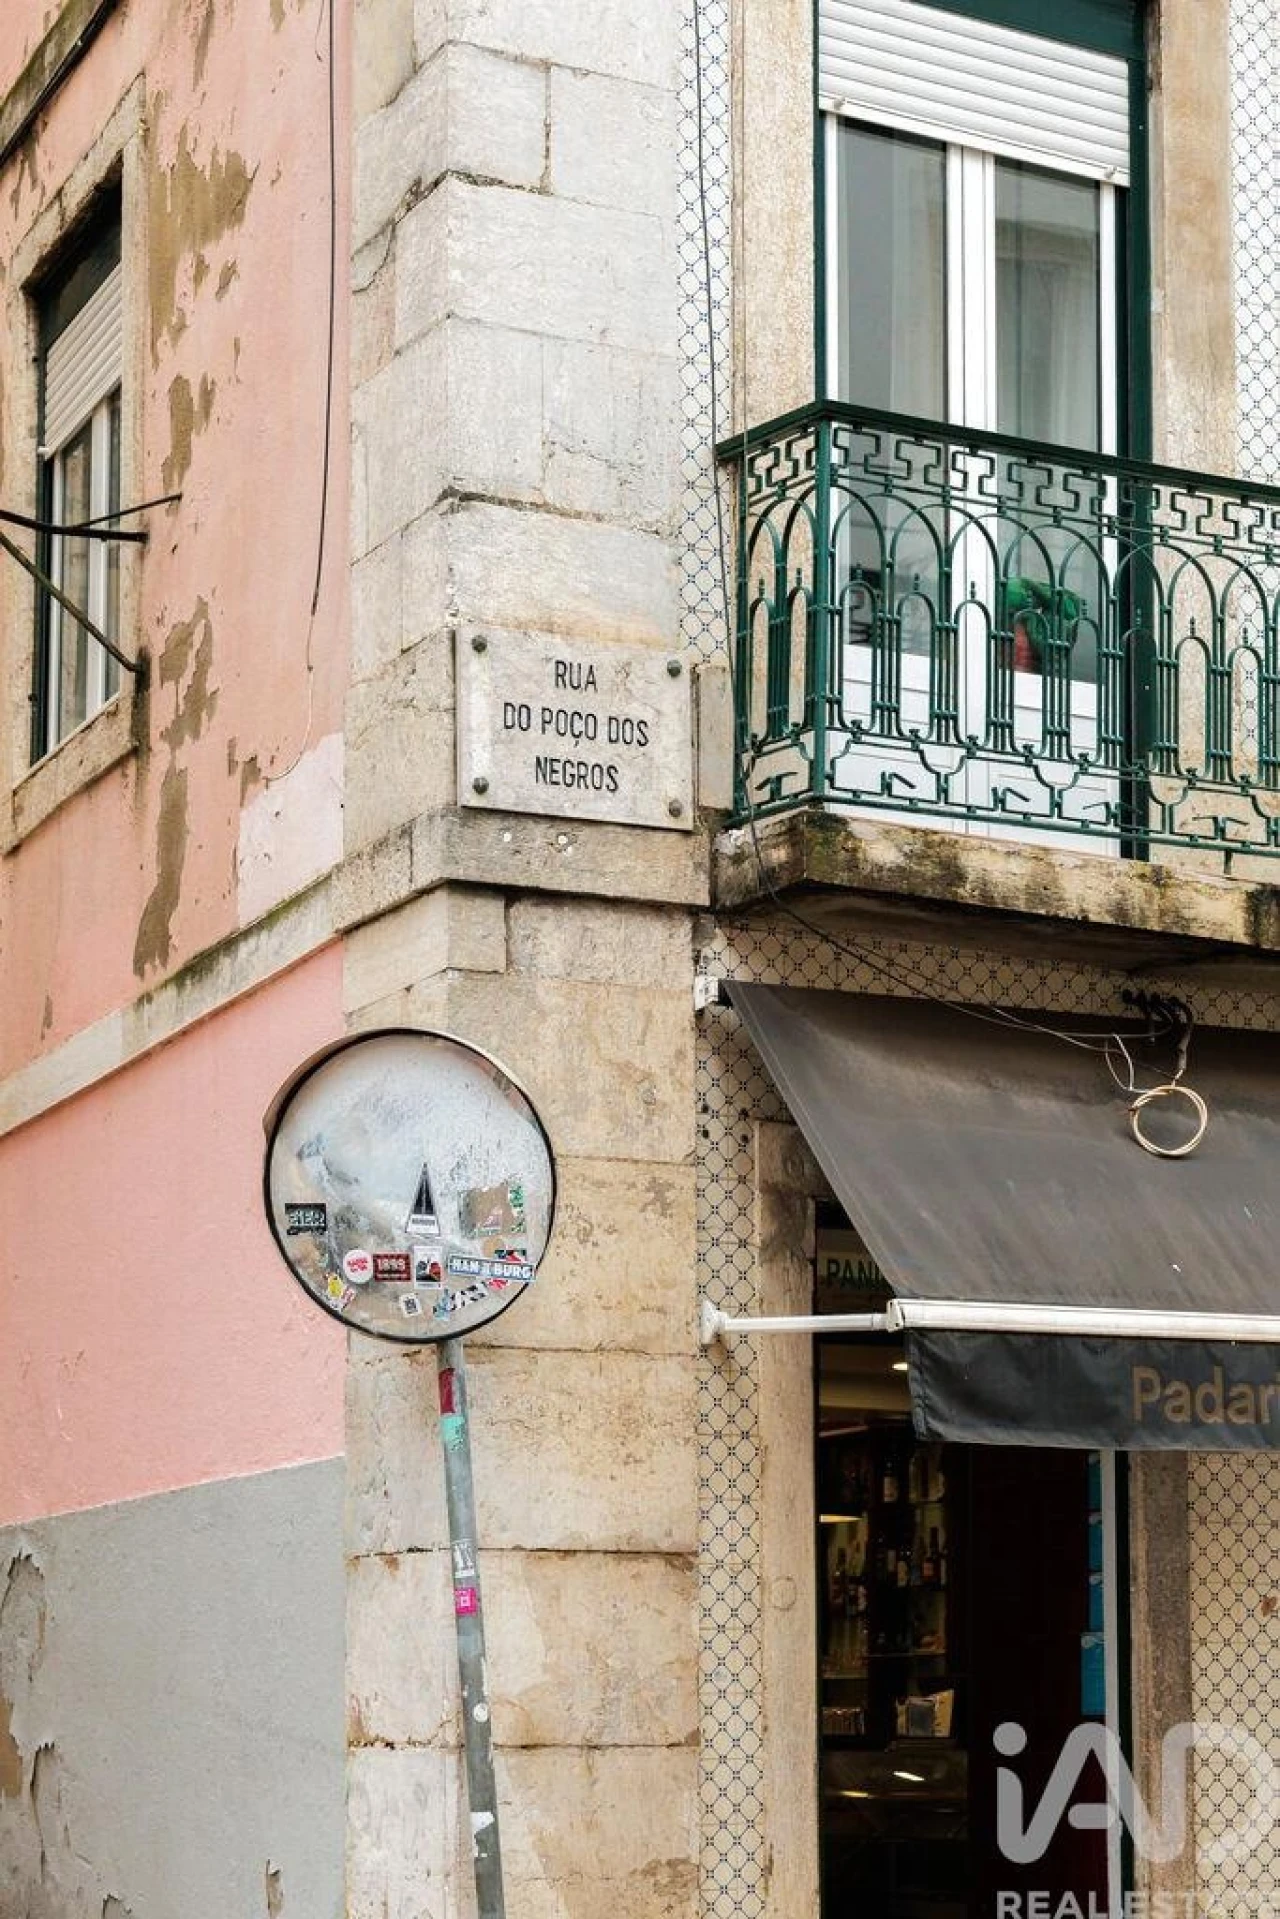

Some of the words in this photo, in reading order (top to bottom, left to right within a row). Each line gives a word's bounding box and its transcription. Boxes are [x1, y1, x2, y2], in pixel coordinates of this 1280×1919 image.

[554, 660, 599, 692] RUA
[503, 702, 532, 731] DO
[541, 707, 598, 748] POÇO
[608, 716, 650, 747] DOS
[535, 755, 620, 793] NEGROS
[1131, 1364, 1280, 1425] Padar
